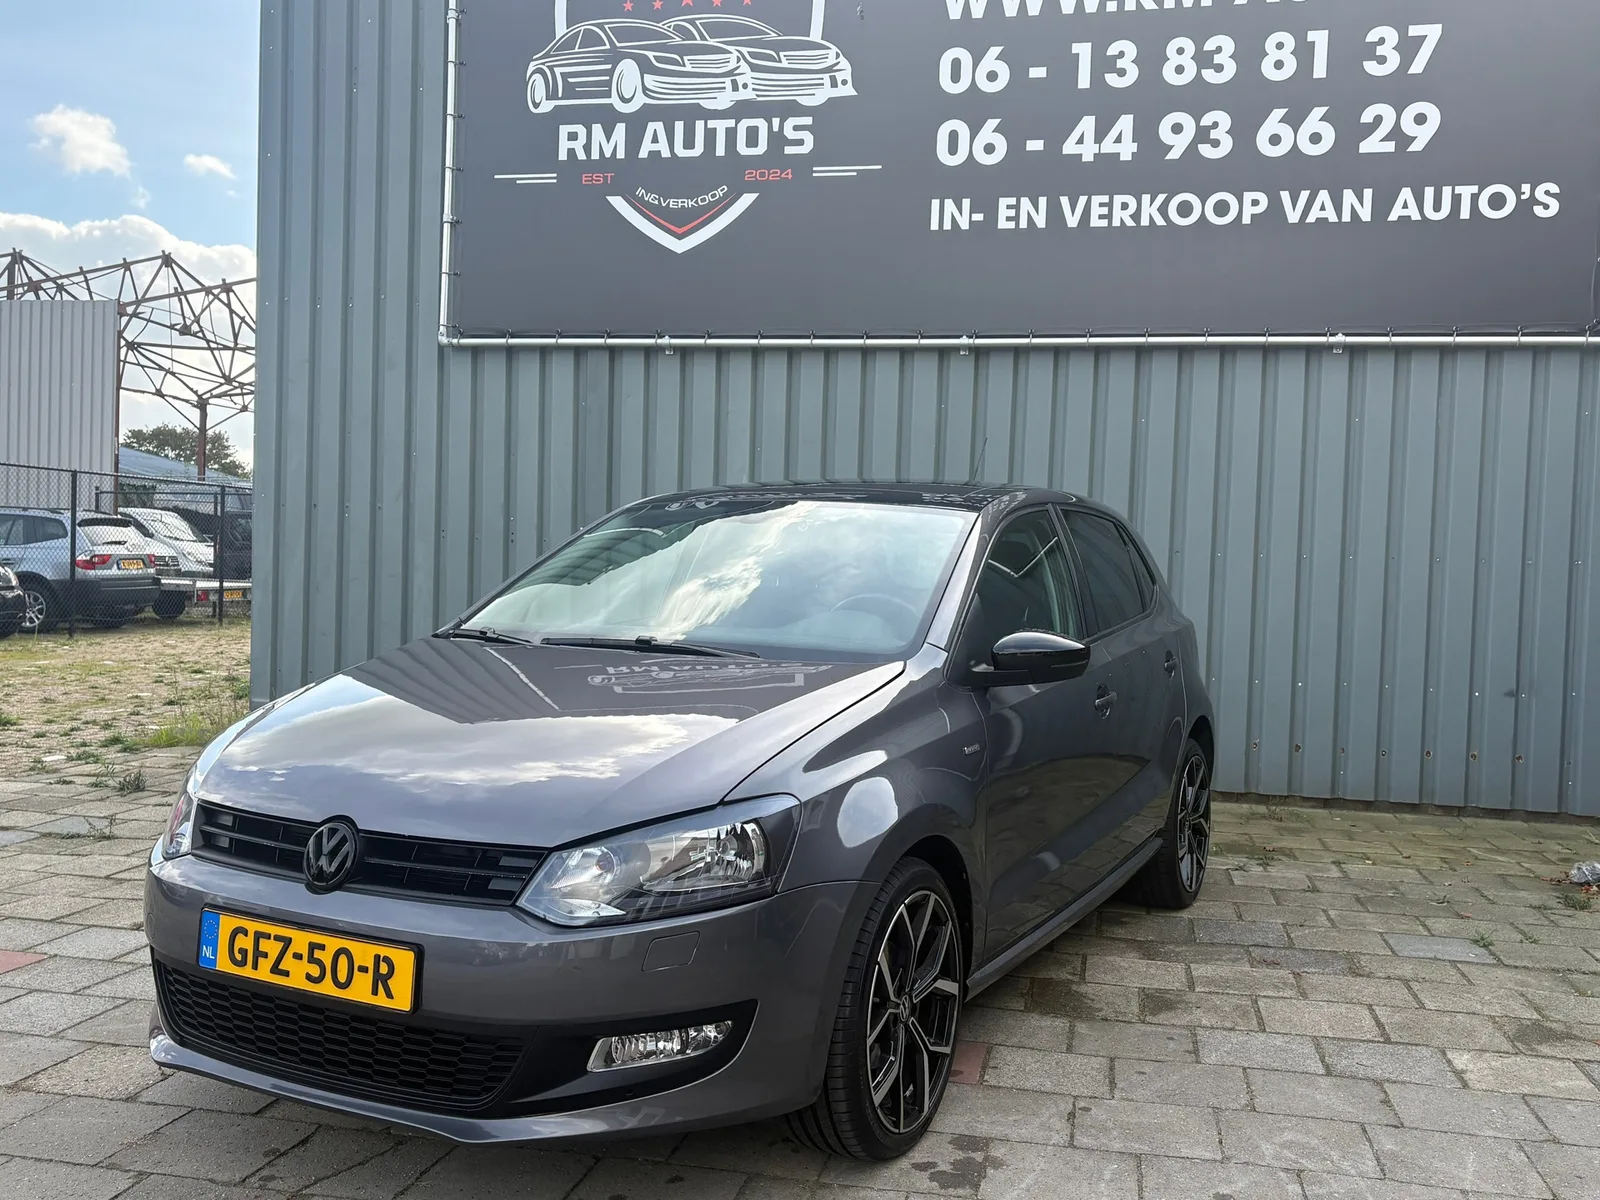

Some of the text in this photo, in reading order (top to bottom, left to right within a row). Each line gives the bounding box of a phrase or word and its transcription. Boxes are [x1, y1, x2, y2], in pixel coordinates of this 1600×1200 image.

[938, 46, 1011, 95] 06
[1071, 39, 1140, 89] 13
[1161, 34, 1237, 86] 83
[1260, 29, 1329, 82] 81
[1362, 23, 1443, 77] 37
[558, 116, 814, 161] RM AUTO'S
[936, 118, 1008, 167] 06
[1062, 113, 1138, 163] 44
[1158, 110, 1234, 160] 93
[1255, 105, 1336, 158] 66
[1358, 101, 1442, 154] 29
[582, 168, 793, 185] EST 2024
[635, 185, 729, 210] IN&VERKOOP
[930, 182, 1561, 231] IN- EN VERKOOP VAN AUTO’S
[202, 925, 396, 1000] NL GFZ-50-R
